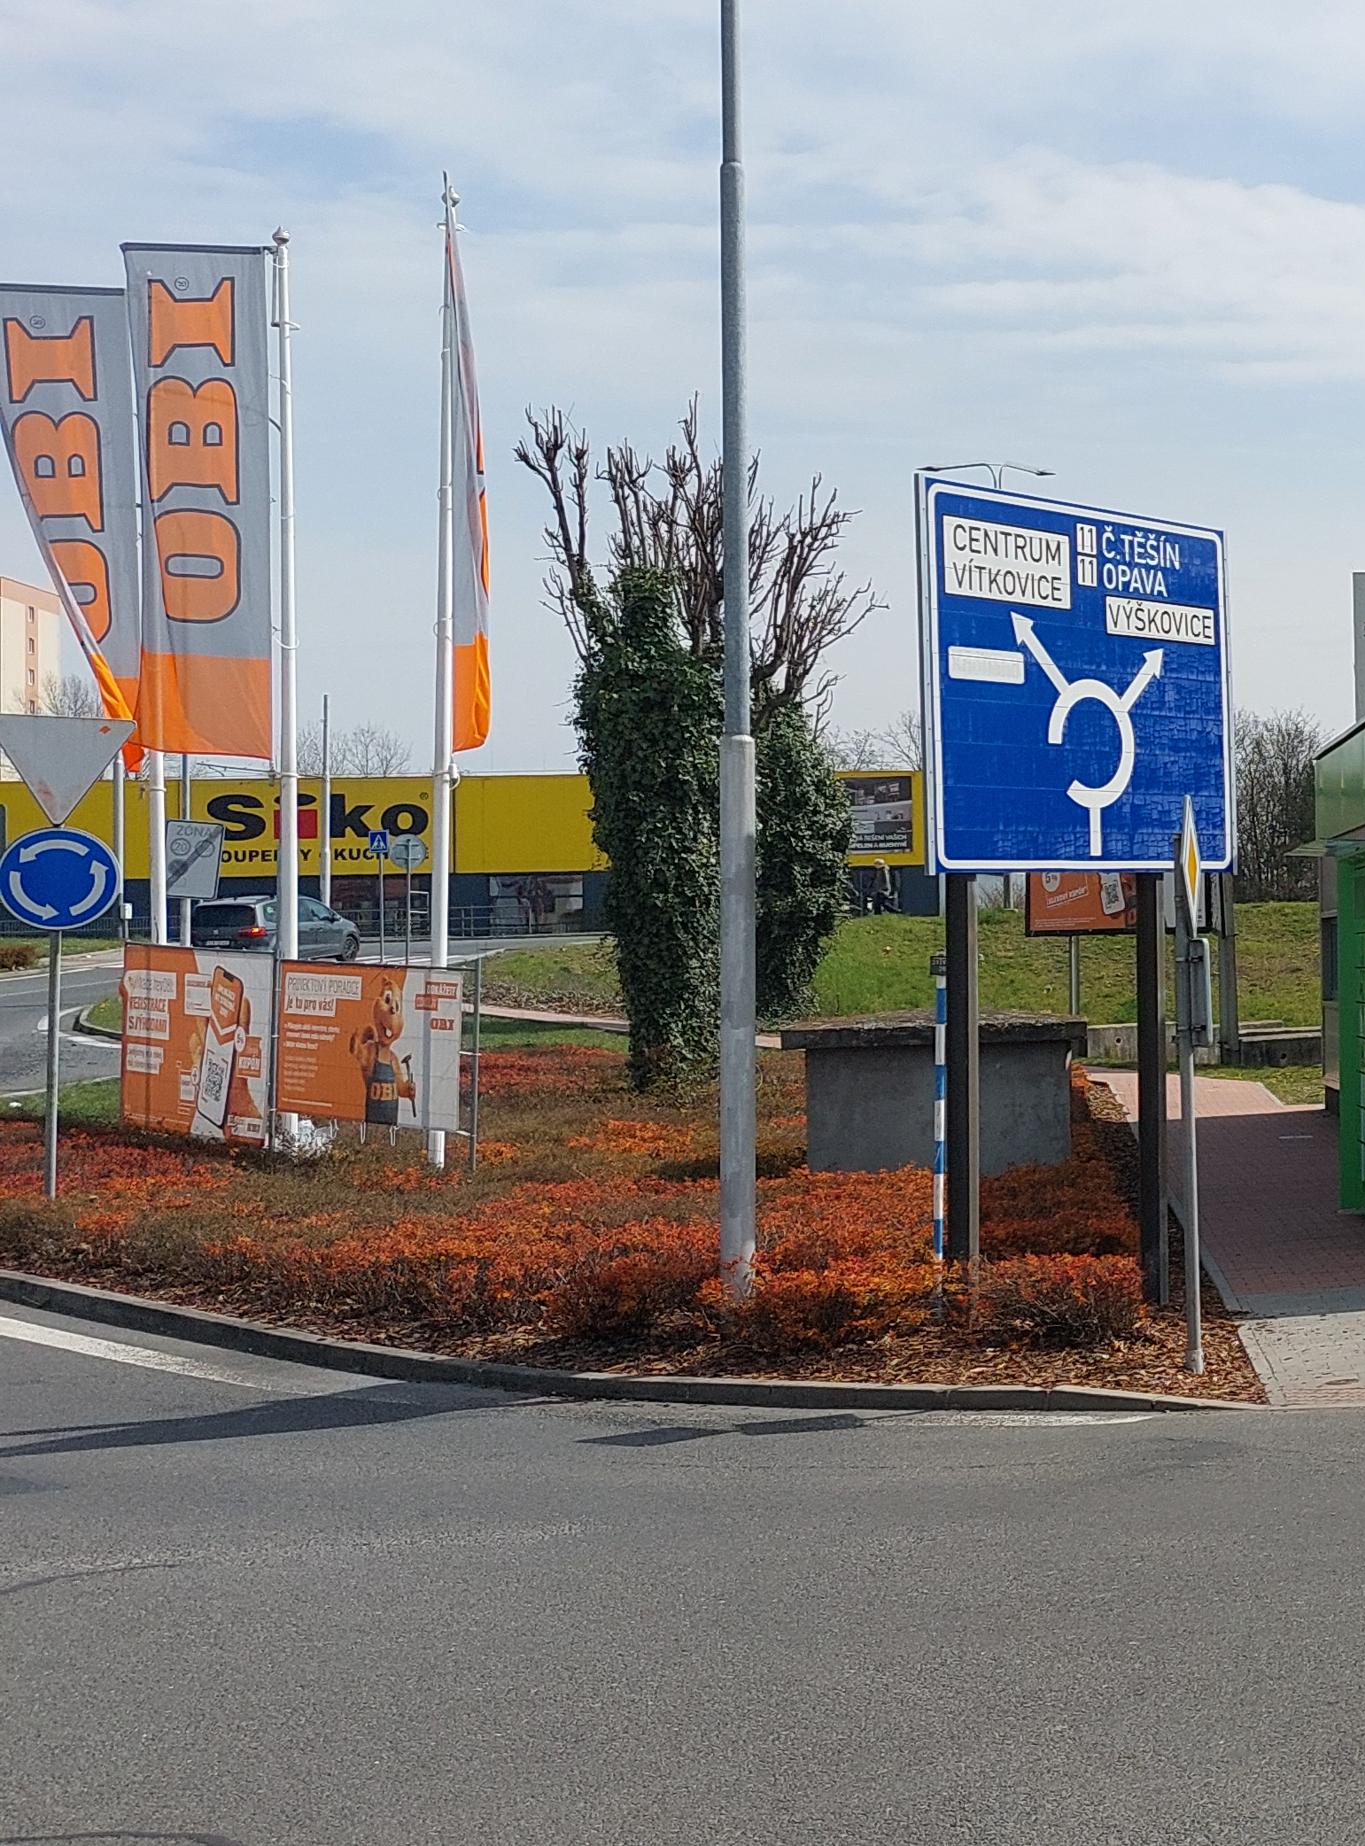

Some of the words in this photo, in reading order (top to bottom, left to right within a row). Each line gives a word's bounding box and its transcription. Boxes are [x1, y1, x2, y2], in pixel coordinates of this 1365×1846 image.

[147, 276, 241, 624] OBI
[3, 315, 111, 645] OBI
[953, 523, 1062, 567] CENTRUM
[1079, 526, 1095, 552] 11
[953, 558, 1063, 602] VÍTKOVICE
[1080, 559, 1096, 583] 11
[1103, 568, 1168, 597] OPAVA
[1109, 603, 1212, 639] VÝŠKOVICE
